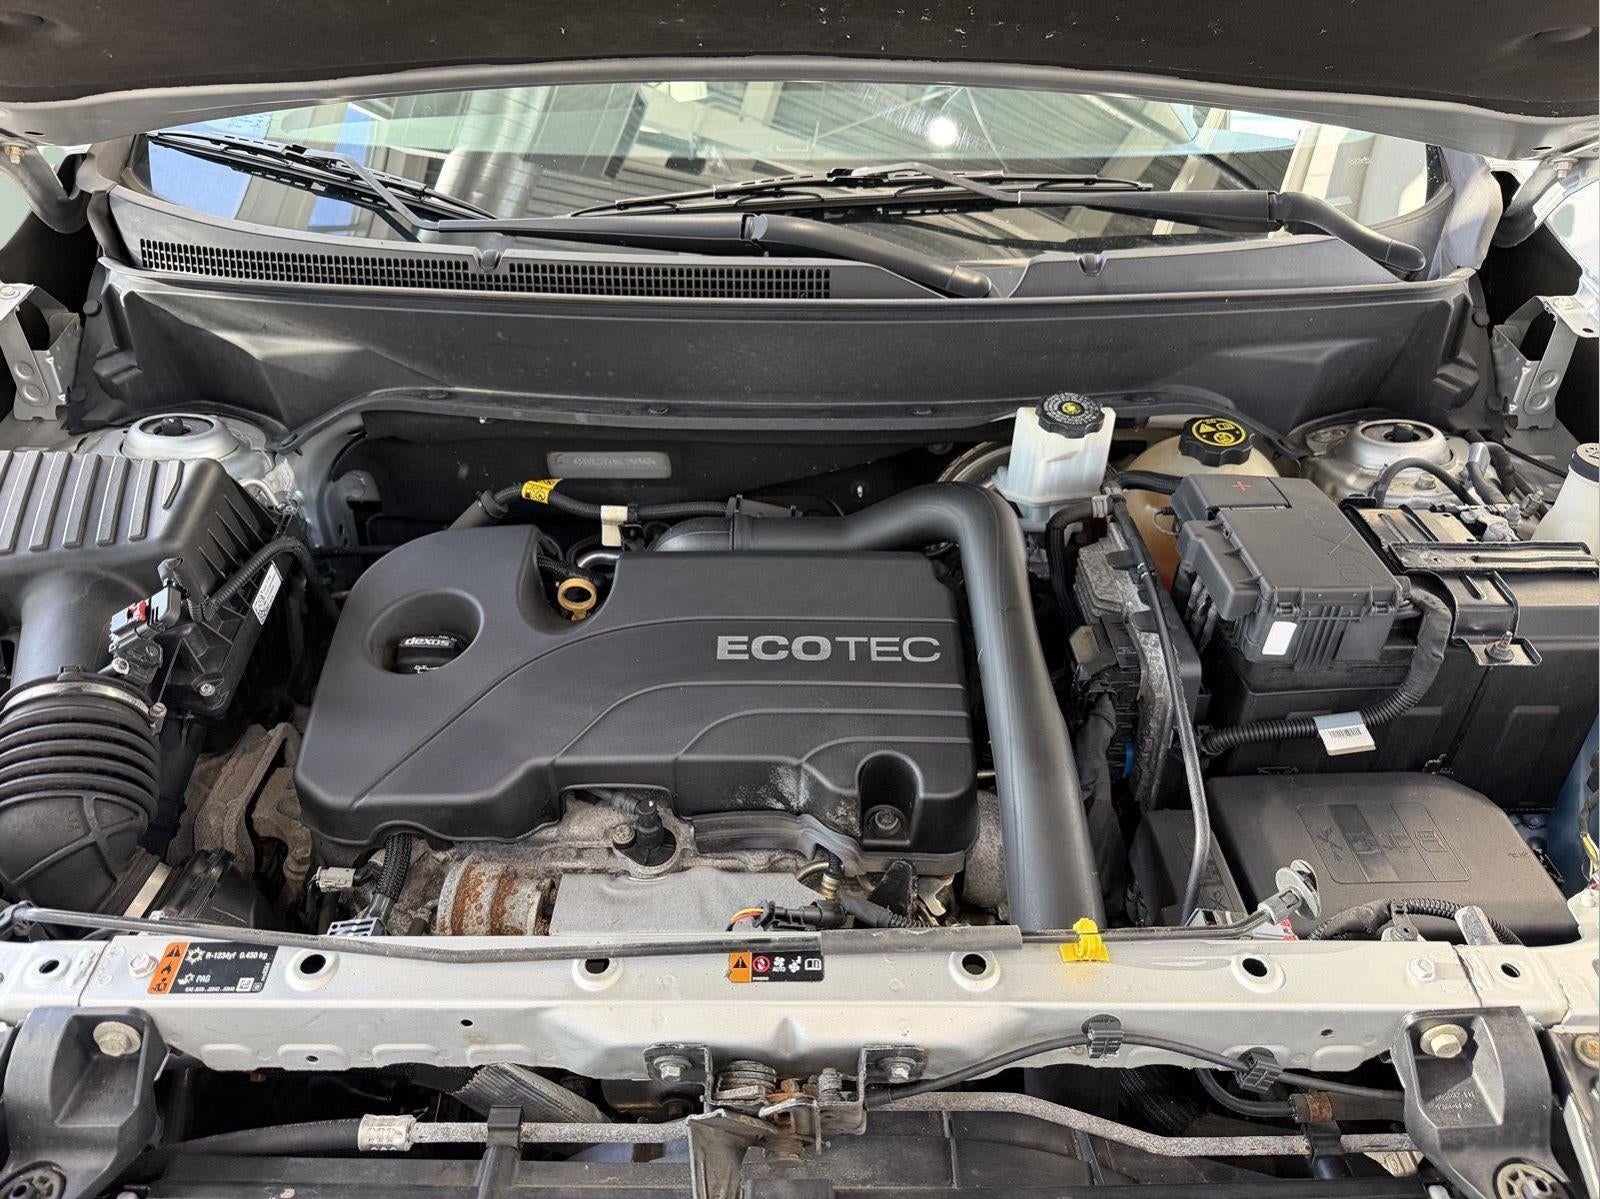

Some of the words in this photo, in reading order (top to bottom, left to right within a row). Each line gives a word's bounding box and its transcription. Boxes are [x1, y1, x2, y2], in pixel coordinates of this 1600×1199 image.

[404, 637, 450, 646] dexos
[716, 635, 941, 662] ECOTEC
[205, 951, 236, 961] R-1234yf
[239, 951, 258, 959] 0.450
[258, 951, 268, 960] kg
[195, 975, 211, 983] PAG
